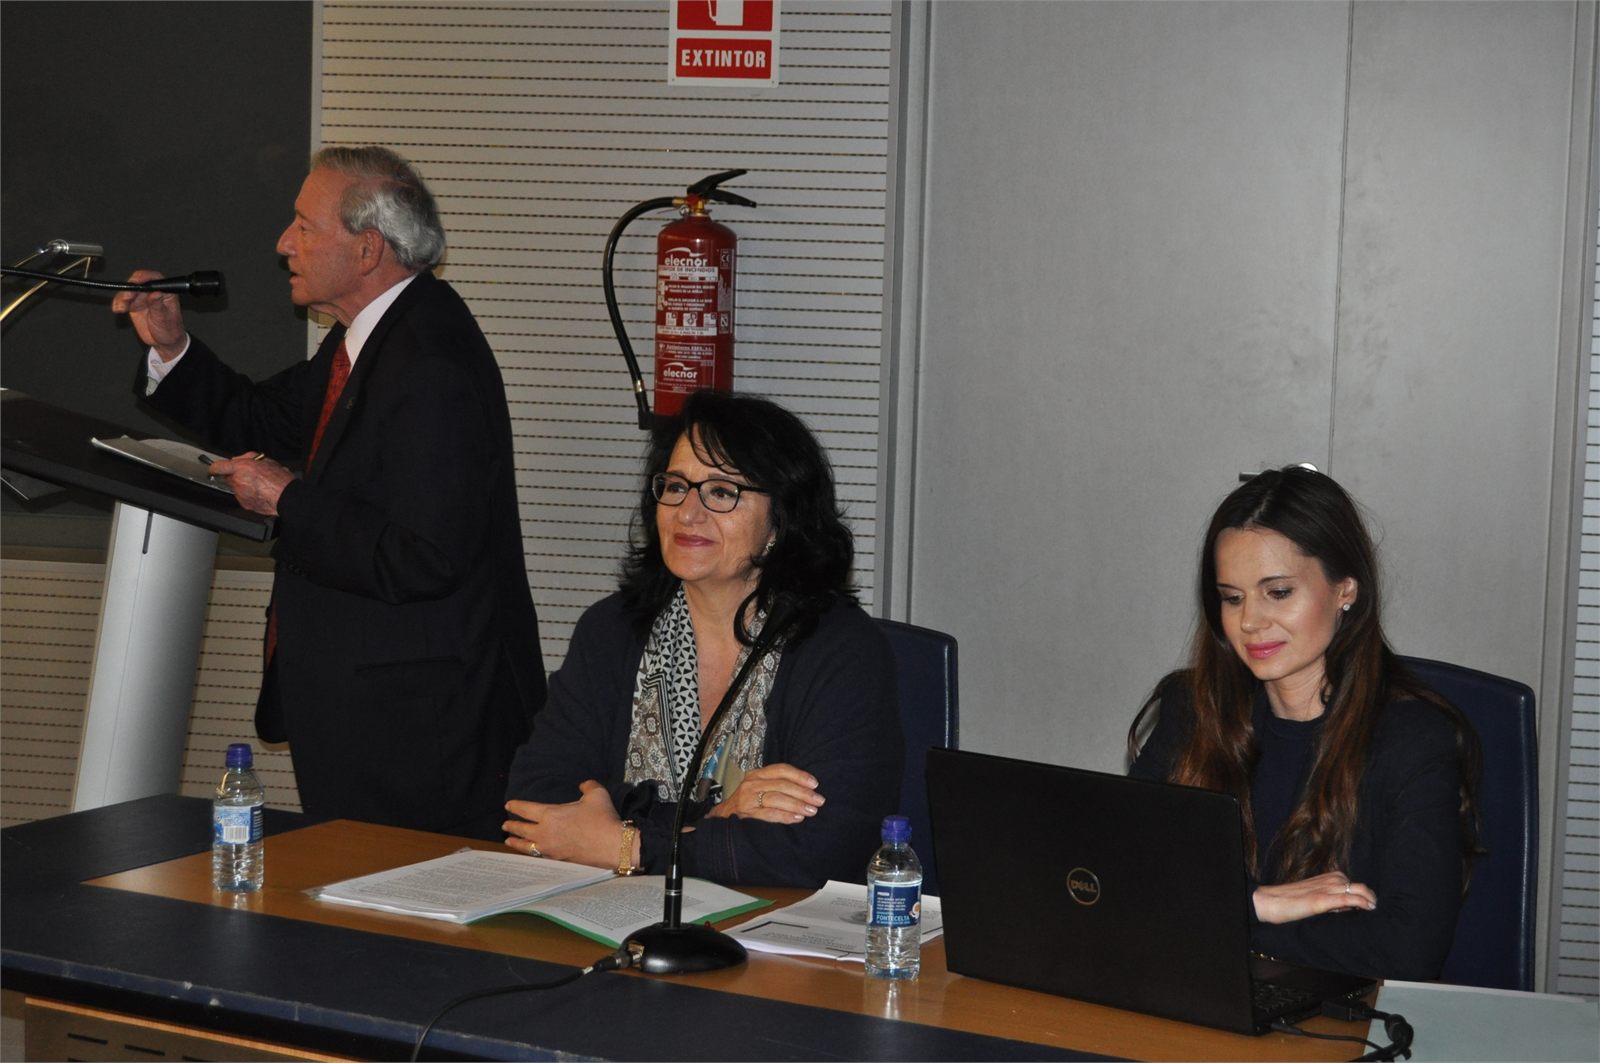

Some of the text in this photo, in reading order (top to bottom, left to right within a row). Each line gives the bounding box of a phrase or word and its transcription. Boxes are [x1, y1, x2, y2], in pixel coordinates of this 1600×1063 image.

[681, 49, 766, 68] EXTINTOR
[664, 254, 708, 266] elecnor
[663, 367, 698, 379] elecnor
[1070, 880, 1097, 893] DELL
